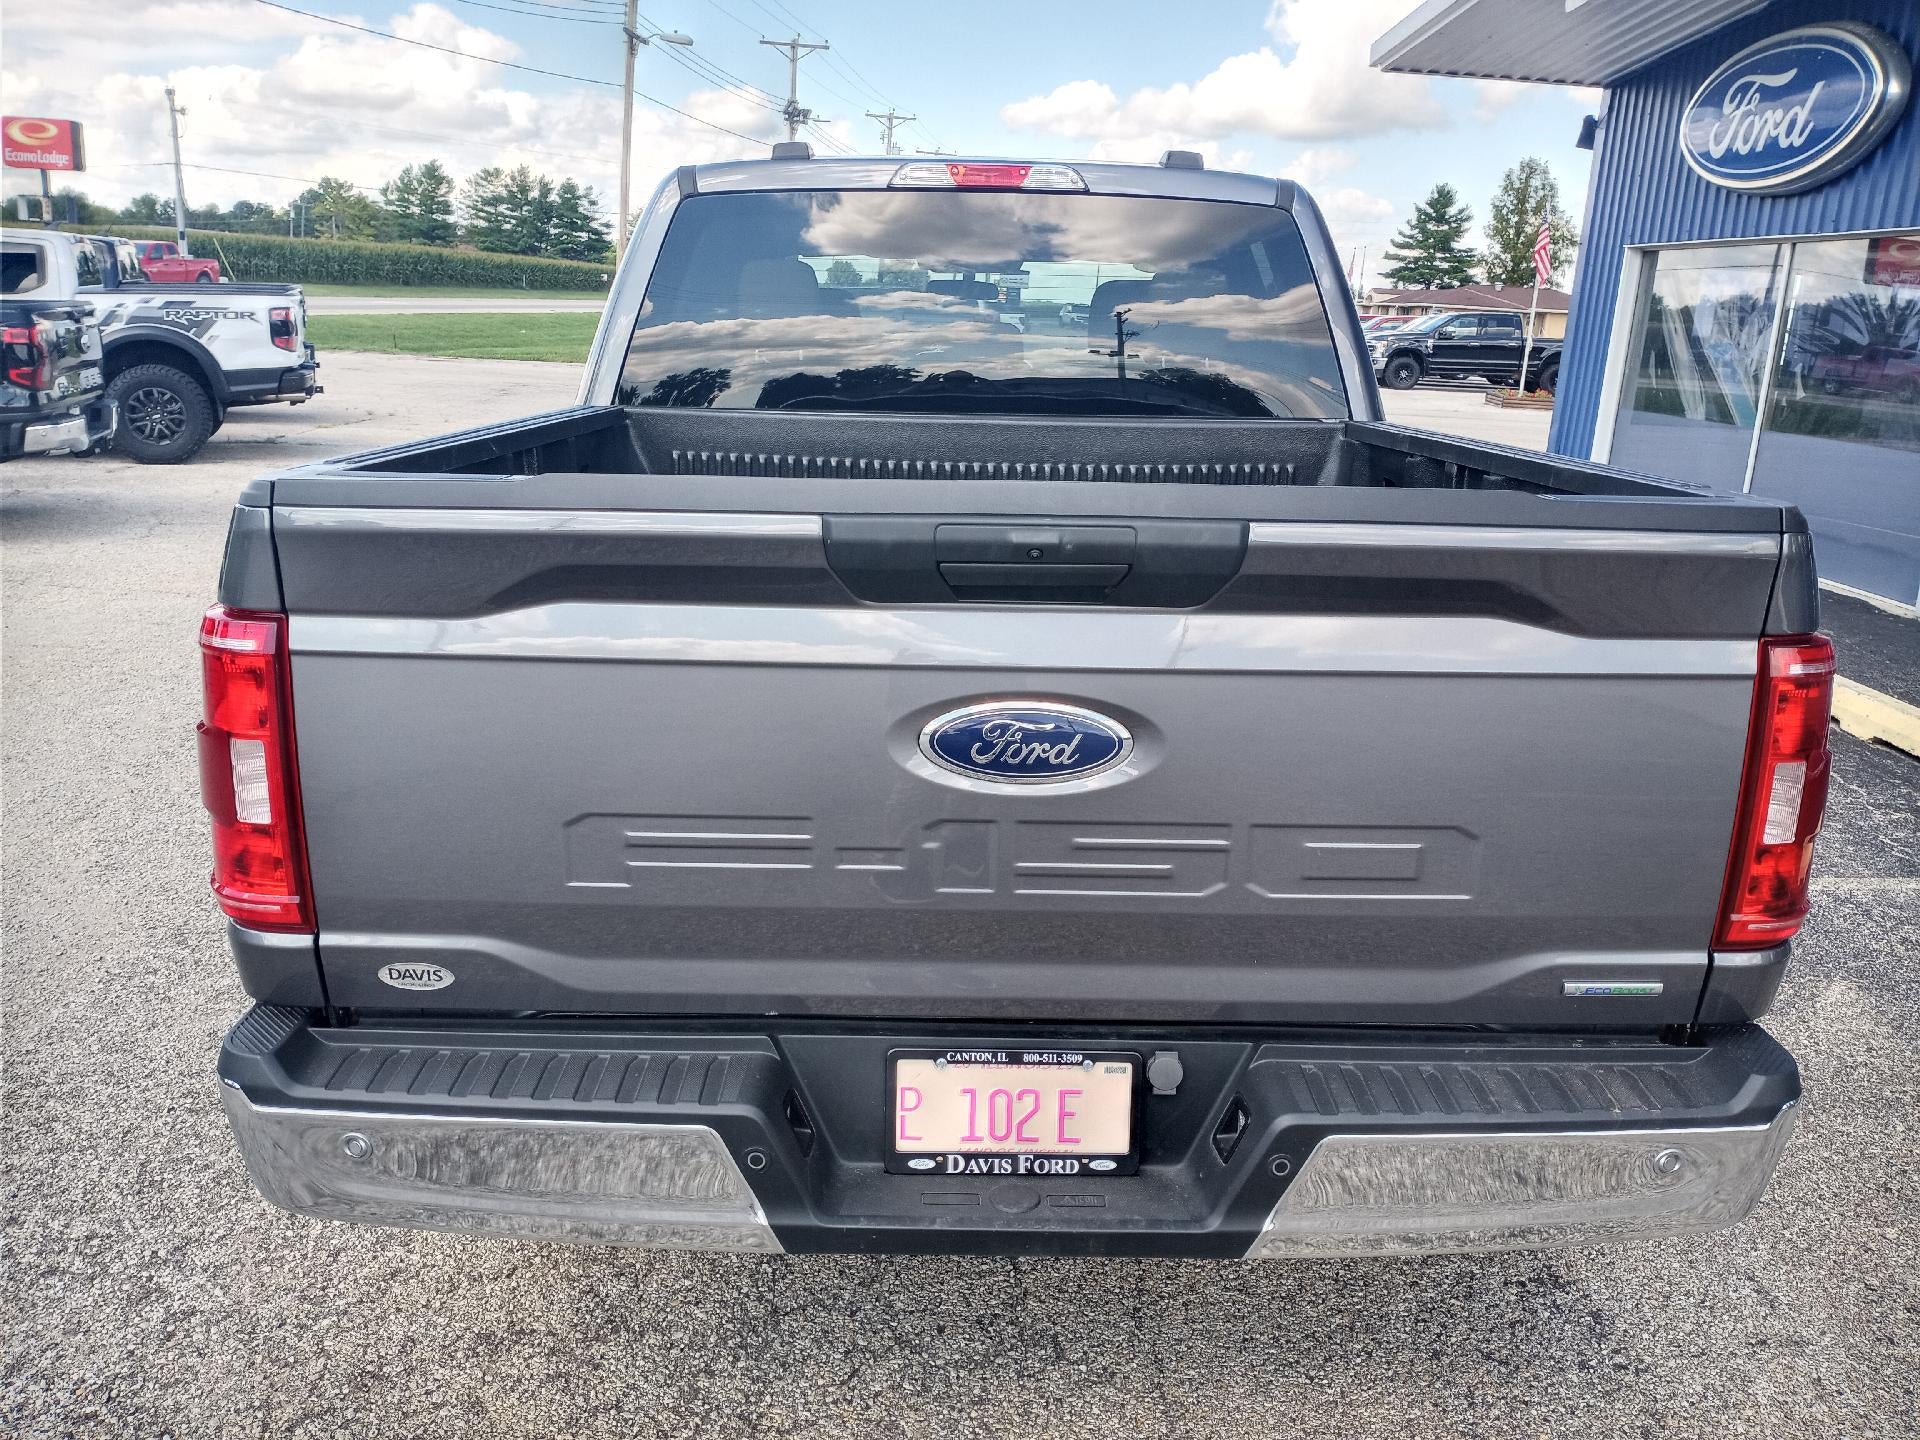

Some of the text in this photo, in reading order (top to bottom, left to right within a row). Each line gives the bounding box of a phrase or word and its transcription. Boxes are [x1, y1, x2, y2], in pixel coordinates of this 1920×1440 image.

[1709, 67, 1825, 159] Ford
[163, 309, 263, 325] RAPTOR
[970, 719, 1083, 765] Ford
[564, 813, 1482, 902] F-150
[388, 967, 443, 982] DAVIS
[946, 1052, 1083, 1064] CANTON, IL 800-511-3509
[959, 1087, 1041, 1143] 102
[1057, 1089, 1083, 1143] E
[945, 1154, 1012, 1174] DAVIS
[1017, 1154, 1080, 1174] FORD
